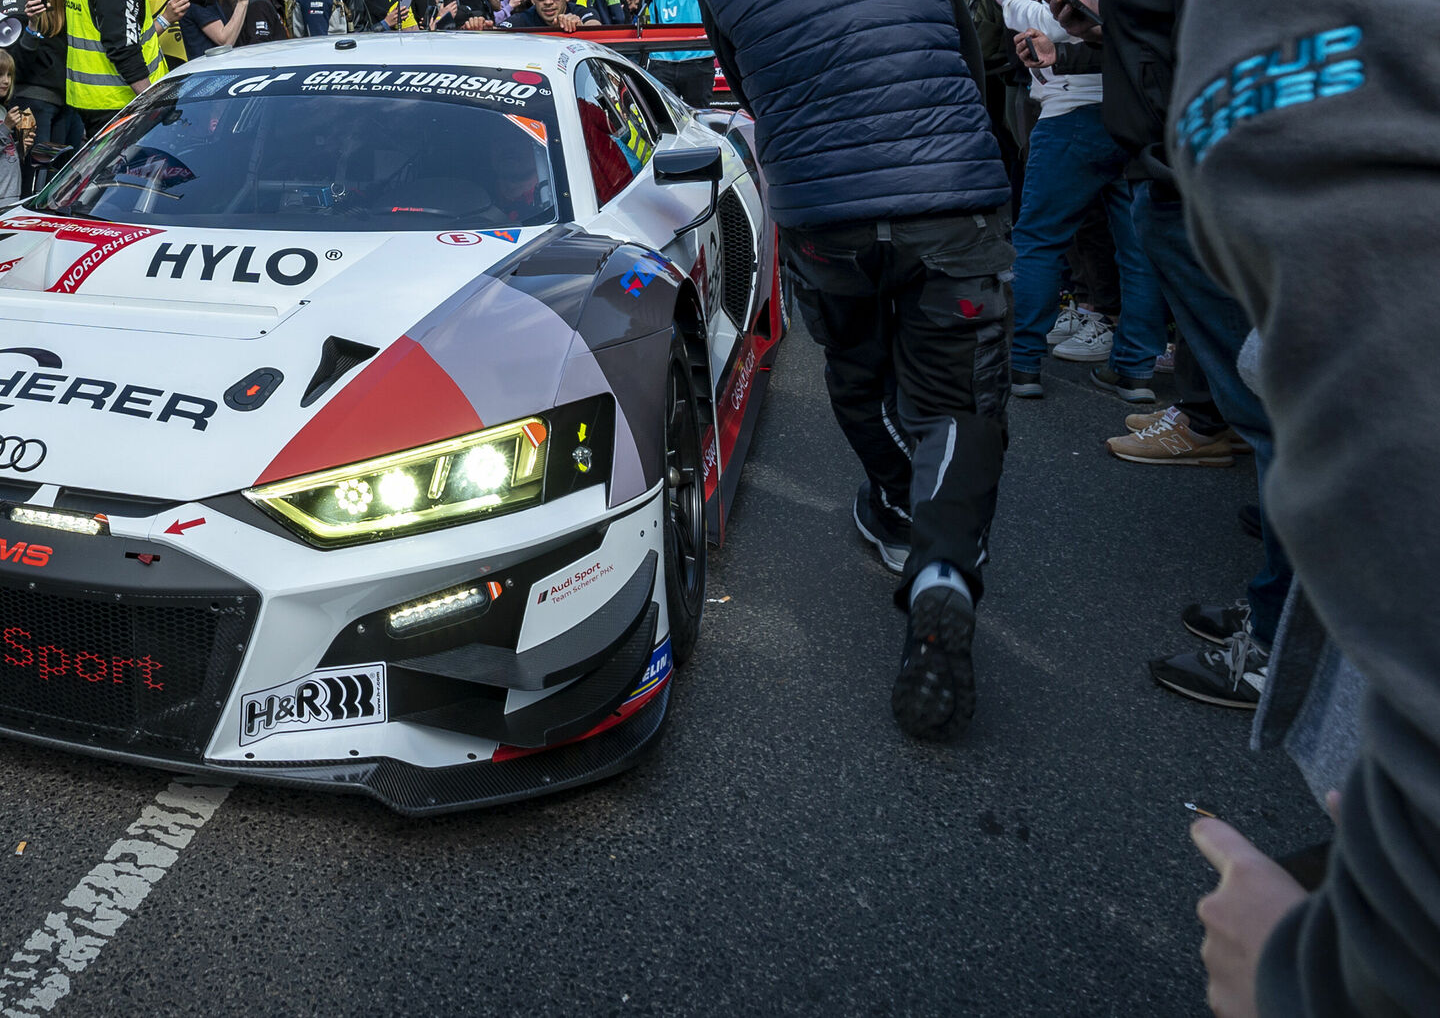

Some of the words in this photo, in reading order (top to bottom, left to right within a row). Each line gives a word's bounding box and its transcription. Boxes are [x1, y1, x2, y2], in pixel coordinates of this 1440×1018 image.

[302, 70, 393, 85] GRAN
[394, 71, 537, 99] TURISMO
[371, 85, 432, 94] DRIVING
[436, 88, 526, 107] SIMULATOR
[449, 234, 471, 244] E
[63, 228, 151, 292] NORDRHEIN
[146, 242, 320, 286] HYLO
[550, 575, 573, 595] Audi
[574, 562, 601, 582] Sport
[551, 589, 572, 604] Team
[572, 575, 599, 594] Scherer
[599, 564, 615, 576] PHX
[2, 626, 165, 691] Sport
[641, 653, 668, 683] ELIN
[246, 682, 323, 733] H&R
